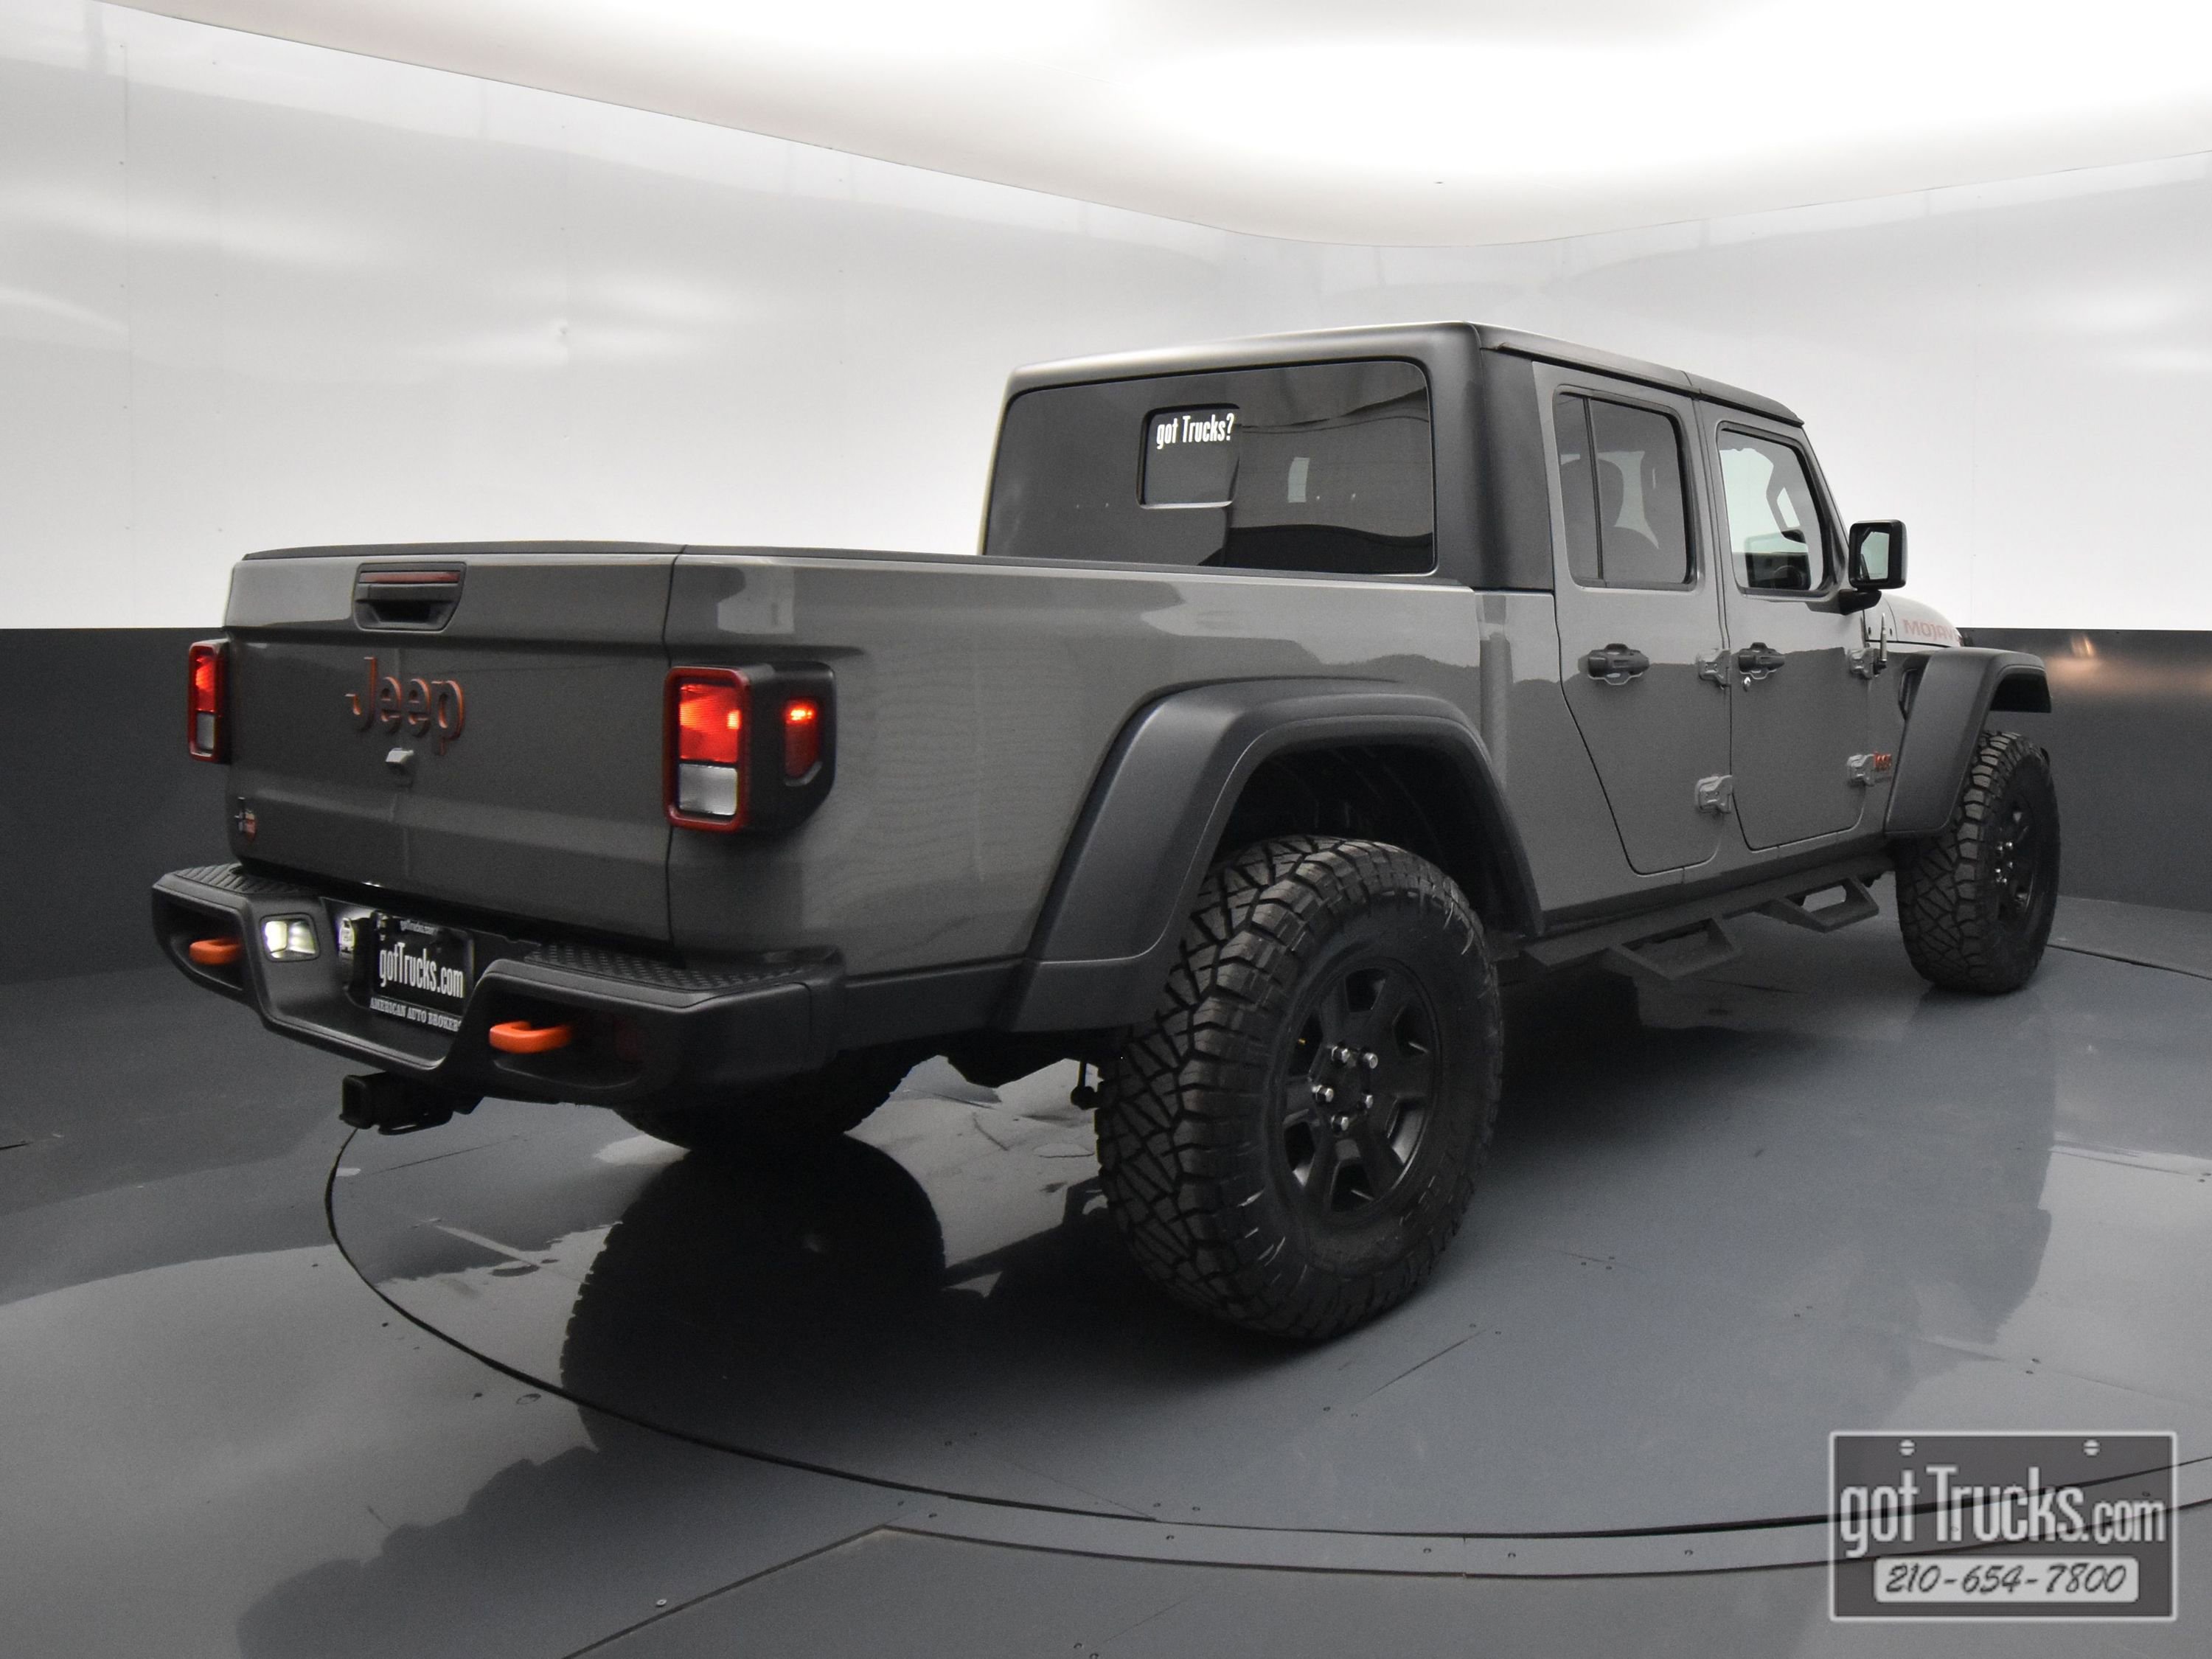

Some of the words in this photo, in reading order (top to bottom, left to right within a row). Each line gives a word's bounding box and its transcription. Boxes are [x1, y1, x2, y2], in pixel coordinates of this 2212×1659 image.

[1156, 418, 1178, 450] got
[1183, 413, 1234, 442] Trucks?
[1902, 618, 1958, 641] MOJAV
[345, 656, 465, 756] Jeep
[370, 997, 406, 1017] AMERICAN
[407, 1007, 427, 1023] AUTO
